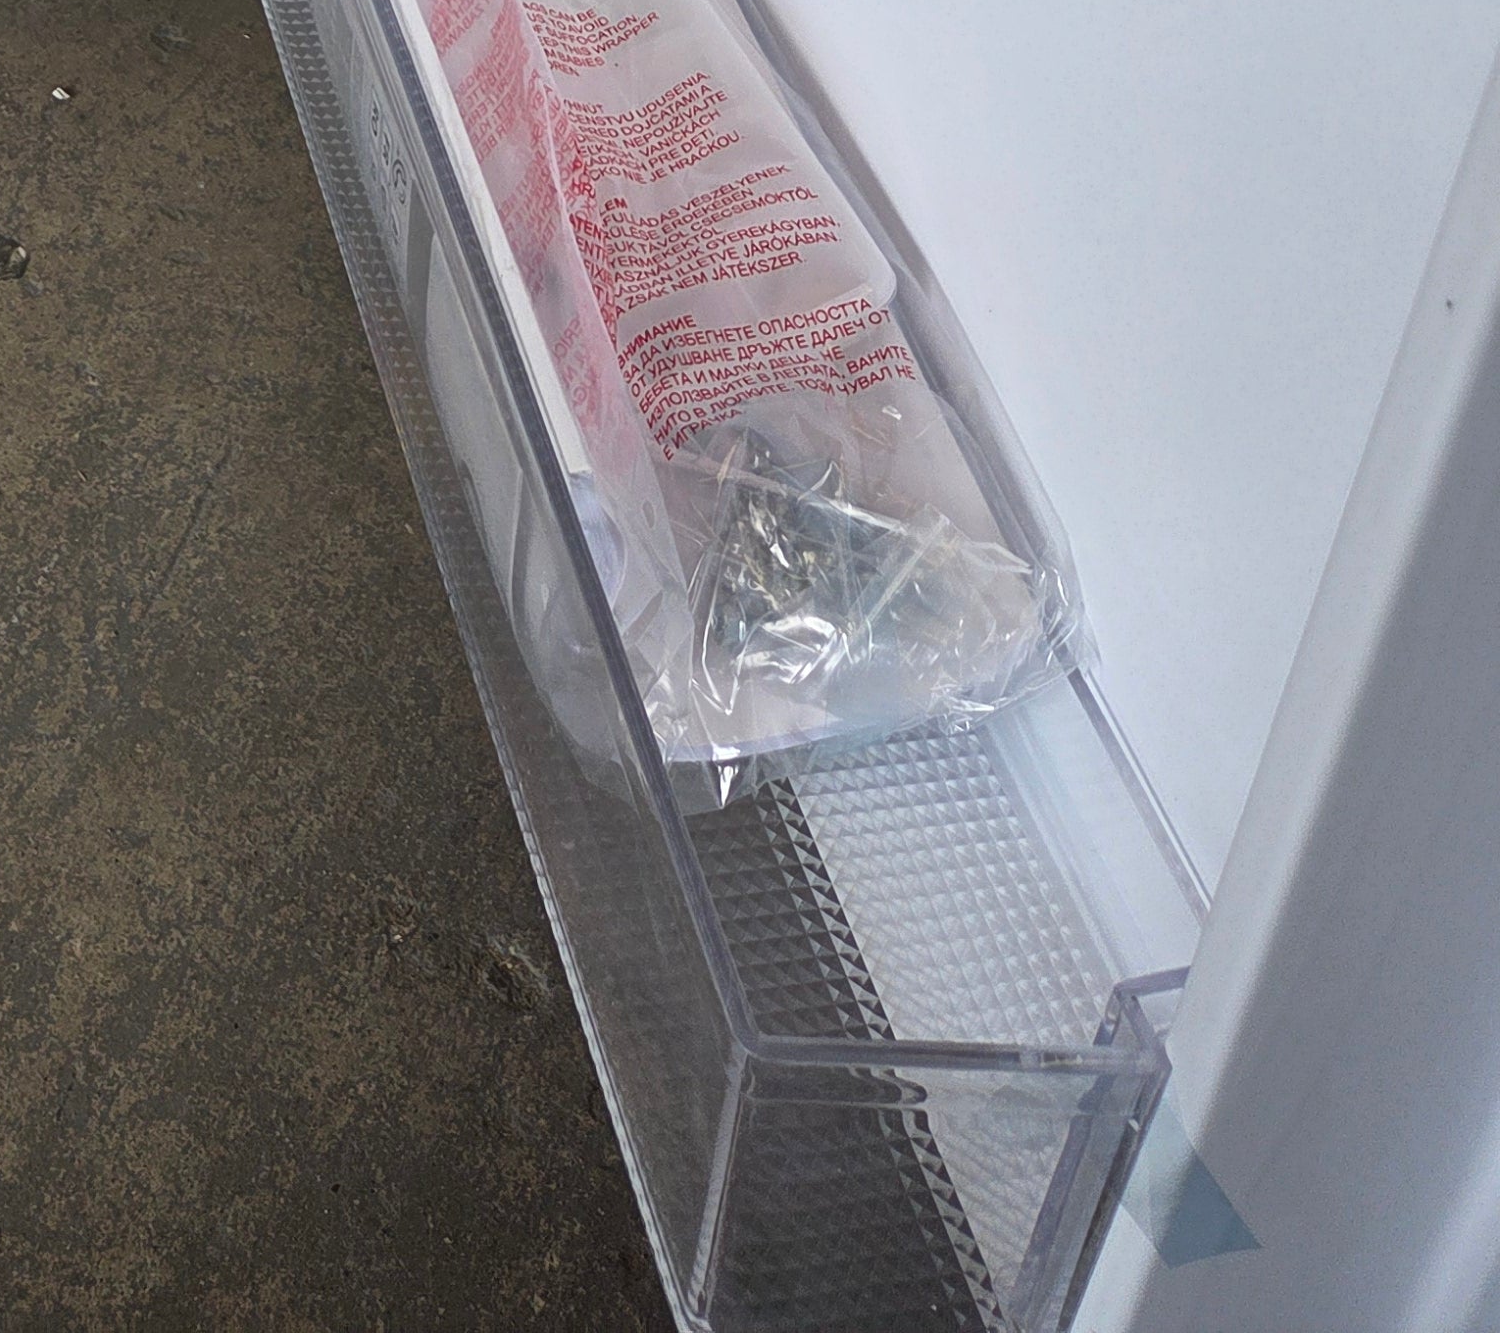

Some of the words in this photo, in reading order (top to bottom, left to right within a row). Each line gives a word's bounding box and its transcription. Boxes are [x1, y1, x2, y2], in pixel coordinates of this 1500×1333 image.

[549, 8, 576, 23] CAN
[577, 7, 597, 23] BE
[550, 19, 567, 32] TO
[568, 15, 609, 33] AVOID
[561, 42, 592, 57] THIS
[593, 11, 660, 55] WRAPPER
[557, 51, 605, 68] BABIES
[700, 84, 712, 97] A
[649, 148, 680, 169] PRE
[622, 168, 649, 185] NIE
[649, 167, 666, 183] JE
[675, 249, 739, 281] ILLETVE
[672, 271, 709, 294] NEM
[623, 363, 641, 384] ЗА
[640, 343, 661, 369] ДА
[661, 324, 756, 352] ИЗБЕГНЕТЕ
[758, 298, 872, 335] ОПАСНОСТТА
[631, 373, 648, 398] ОТ
[647, 346, 735, 379] УДУШВАНЕ
[737, 333, 809, 362] ДРЪЖТЕ
[811, 317, 867, 349] ДАЛЕЧ
[868, 309, 891, 325] ОТ
[639, 372, 693, 415] БЕБЕТА
[693, 369, 706, 385] И
[709, 361, 767, 382] МАЛКИ
[820, 345, 845, 362] НЕ
[647, 373, 756, 430] ИЗПОЛЗВАЙТЕ
[756, 370, 771, 384] В
[654, 409, 692, 445] НИТО
[693, 406, 707, 419] В
[794, 378, 836, 397] ТОЗИ
[836, 365, 893, 397] ЧУВАЛ
[895, 364, 917, 381] НЕ
[663, 444, 675, 461] Е
